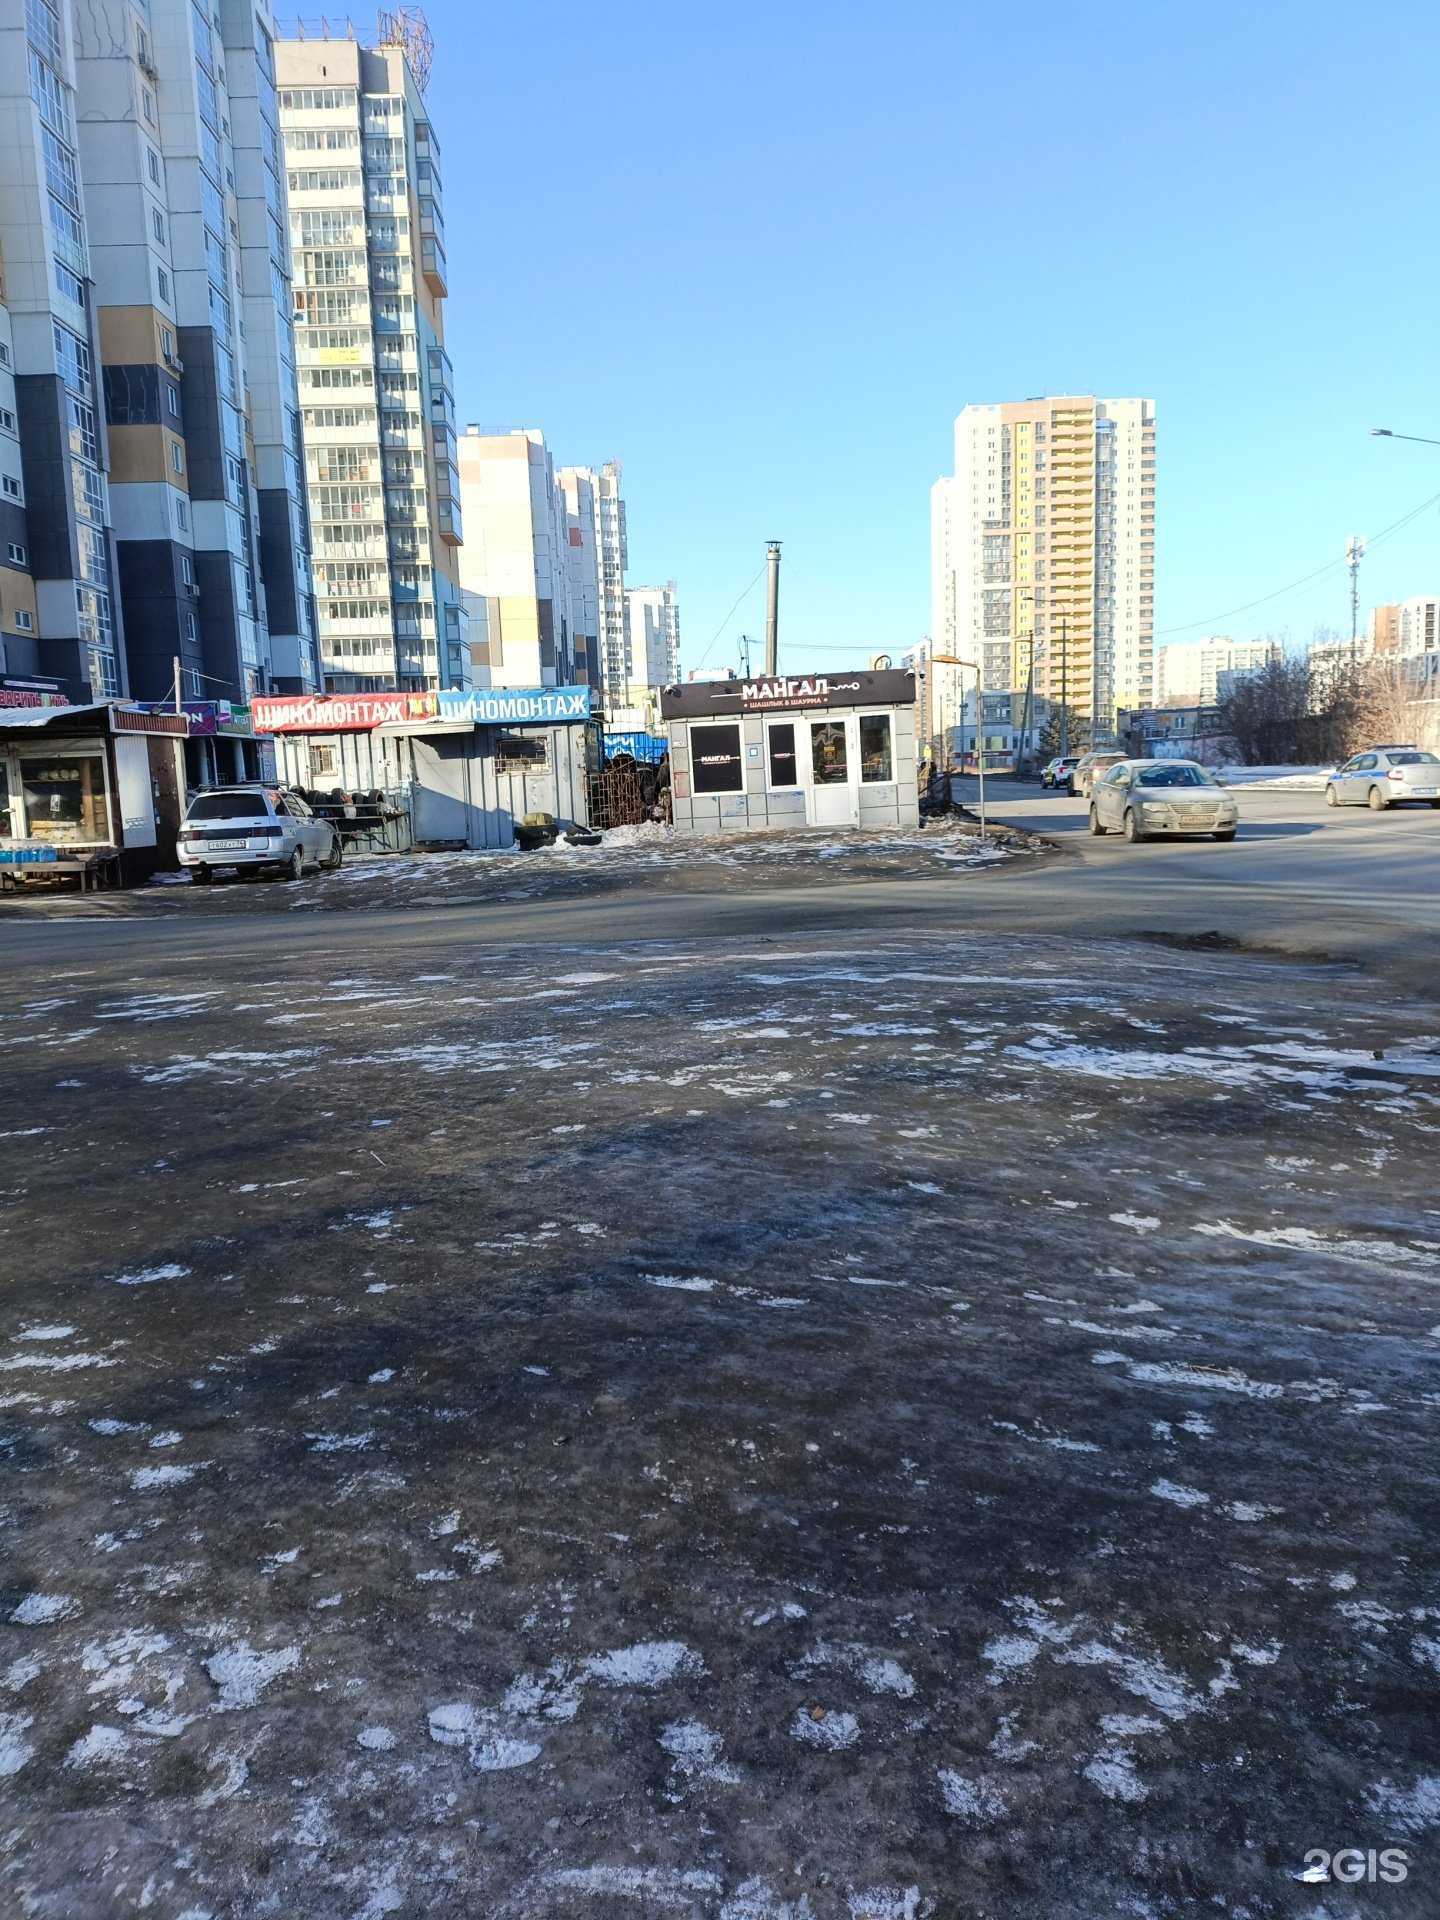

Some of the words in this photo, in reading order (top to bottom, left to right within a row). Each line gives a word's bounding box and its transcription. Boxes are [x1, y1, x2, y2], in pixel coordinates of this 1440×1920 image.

[742, 679, 827, 700] МАНГАЛ
[255, 701, 404, 728] ШИНОМОНТАЖ
[440, 694, 587, 720] ШИНОМОНТАЖ
